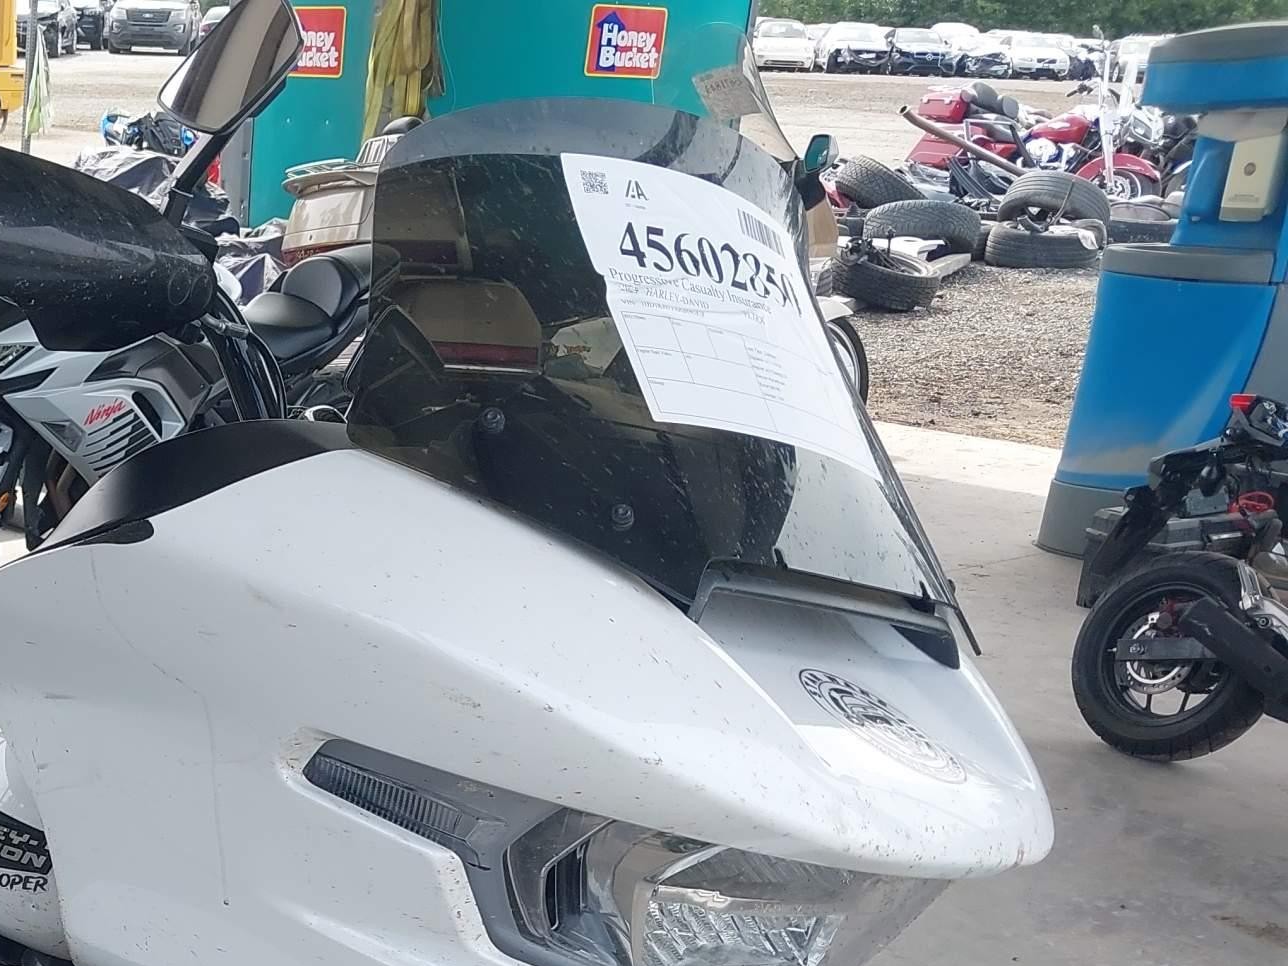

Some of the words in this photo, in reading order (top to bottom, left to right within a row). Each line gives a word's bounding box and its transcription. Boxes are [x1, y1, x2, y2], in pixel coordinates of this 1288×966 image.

[601, 23, 657, 52] Honey
[599, 47, 659, 69] Bucket
[620, 222, 802, 317] 45602850
[609, 268, 679, 288] Progressive
[682, 278, 725, 302] Casualty
[83, 398, 126, 426] Ninja
